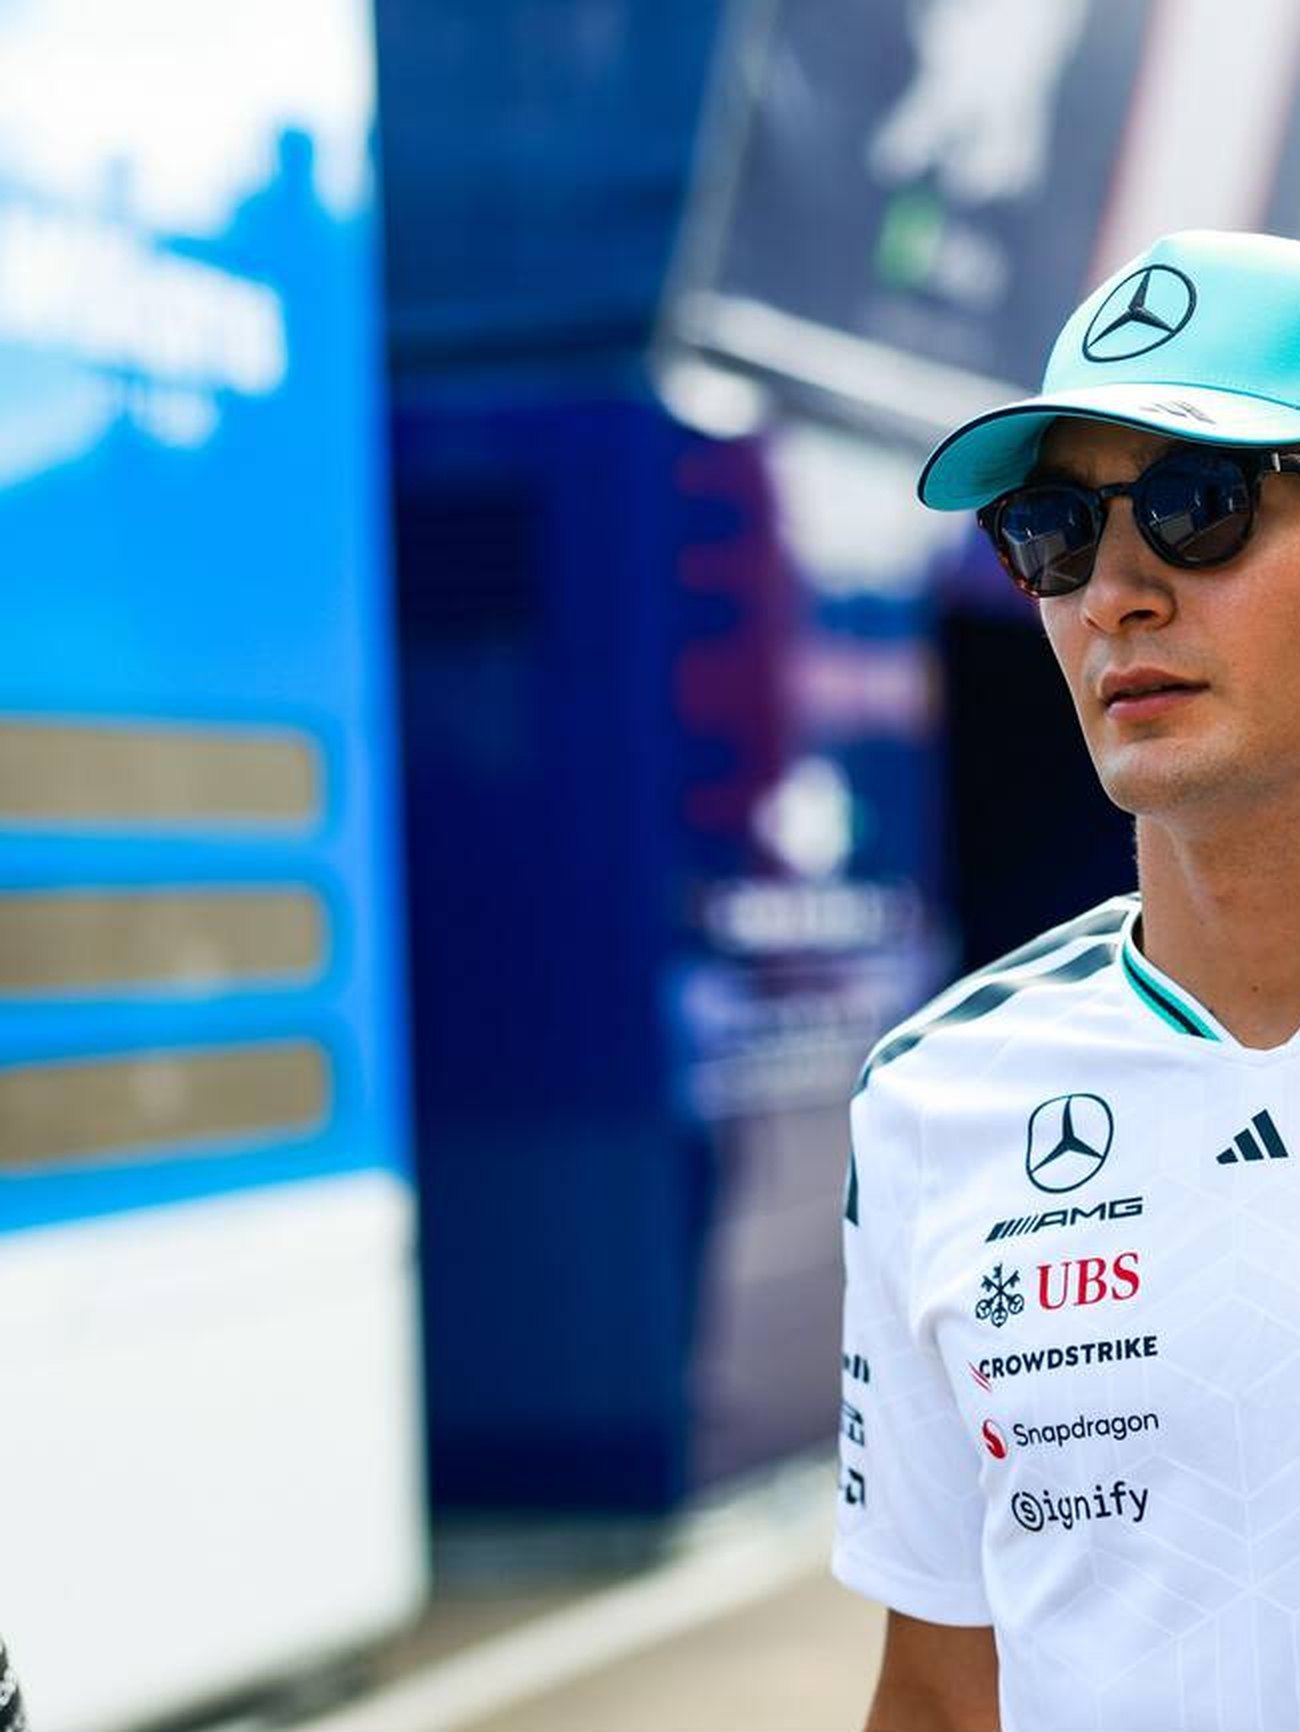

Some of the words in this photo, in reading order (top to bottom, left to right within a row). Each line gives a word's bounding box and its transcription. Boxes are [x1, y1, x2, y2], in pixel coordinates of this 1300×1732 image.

[1031, 1196, 1143, 1233] AMG
[1036, 1252, 1141, 1310] UBS
[978, 1335, 1159, 1380] CROWDSTRIKE
[1012, 1412, 1160, 1448] Snapdragon
